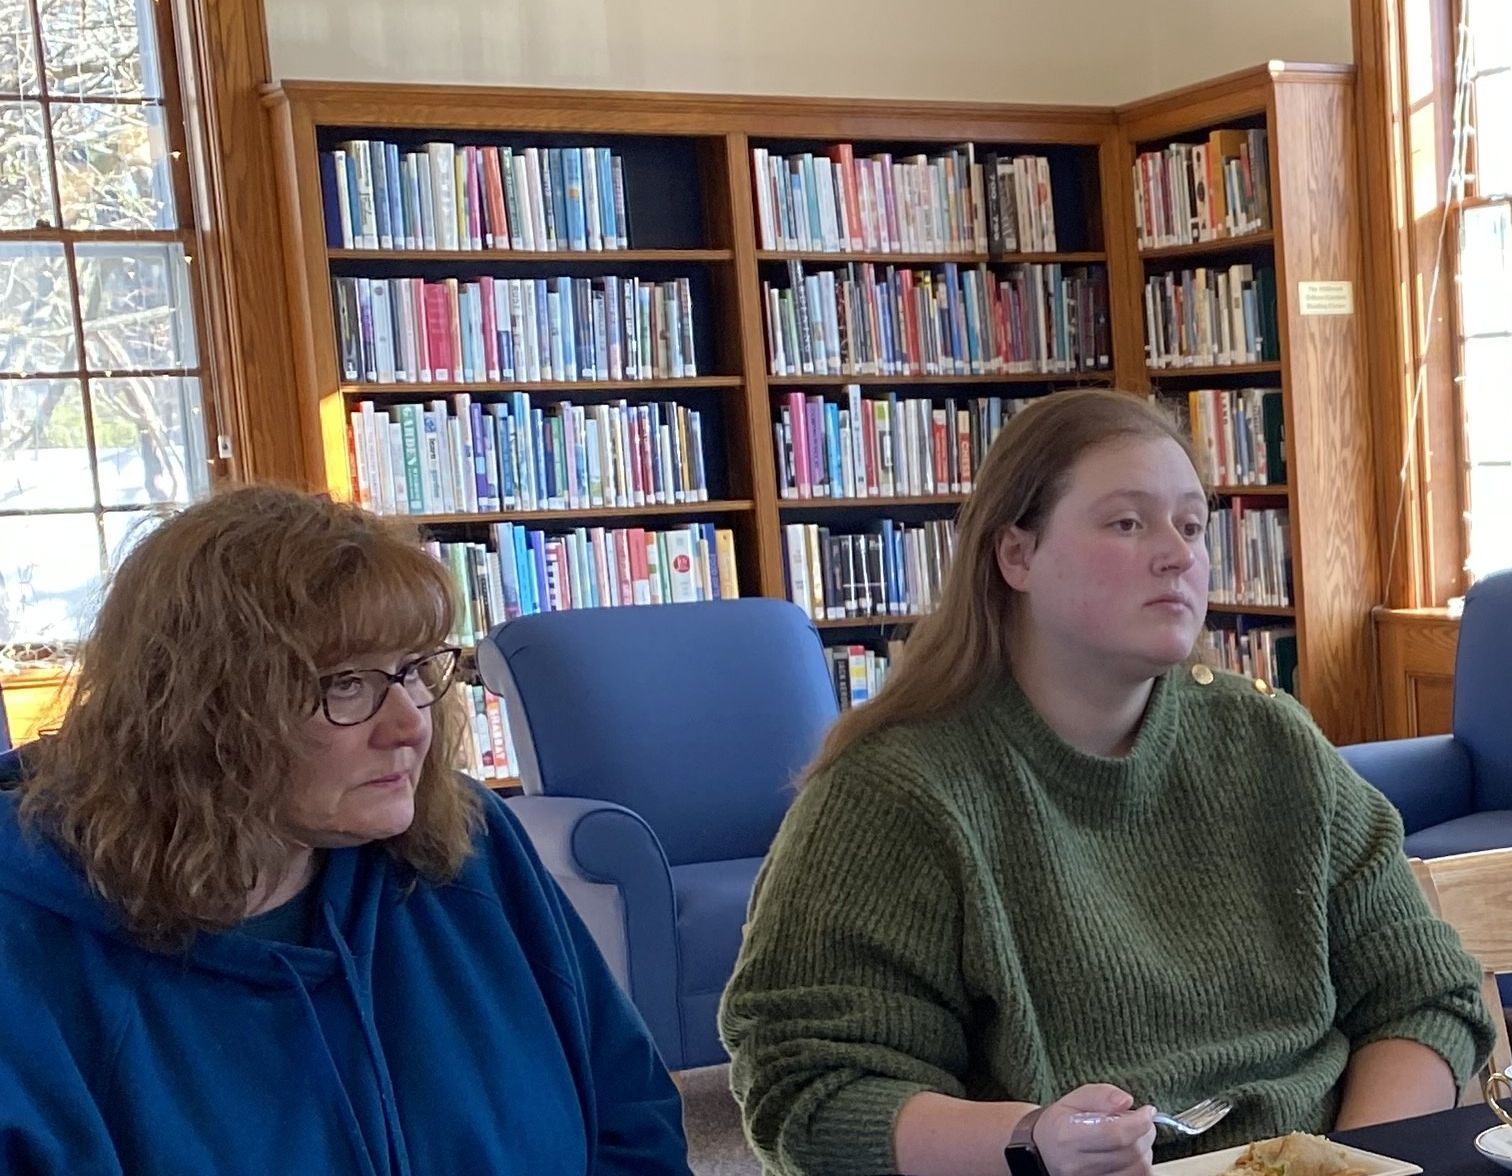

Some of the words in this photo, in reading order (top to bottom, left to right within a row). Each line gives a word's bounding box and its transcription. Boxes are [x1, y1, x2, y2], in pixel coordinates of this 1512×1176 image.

[989, 174, 997, 200] 700
[402, 406, 417, 466] GARDEN
[960, 441, 970, 478] CHESS
